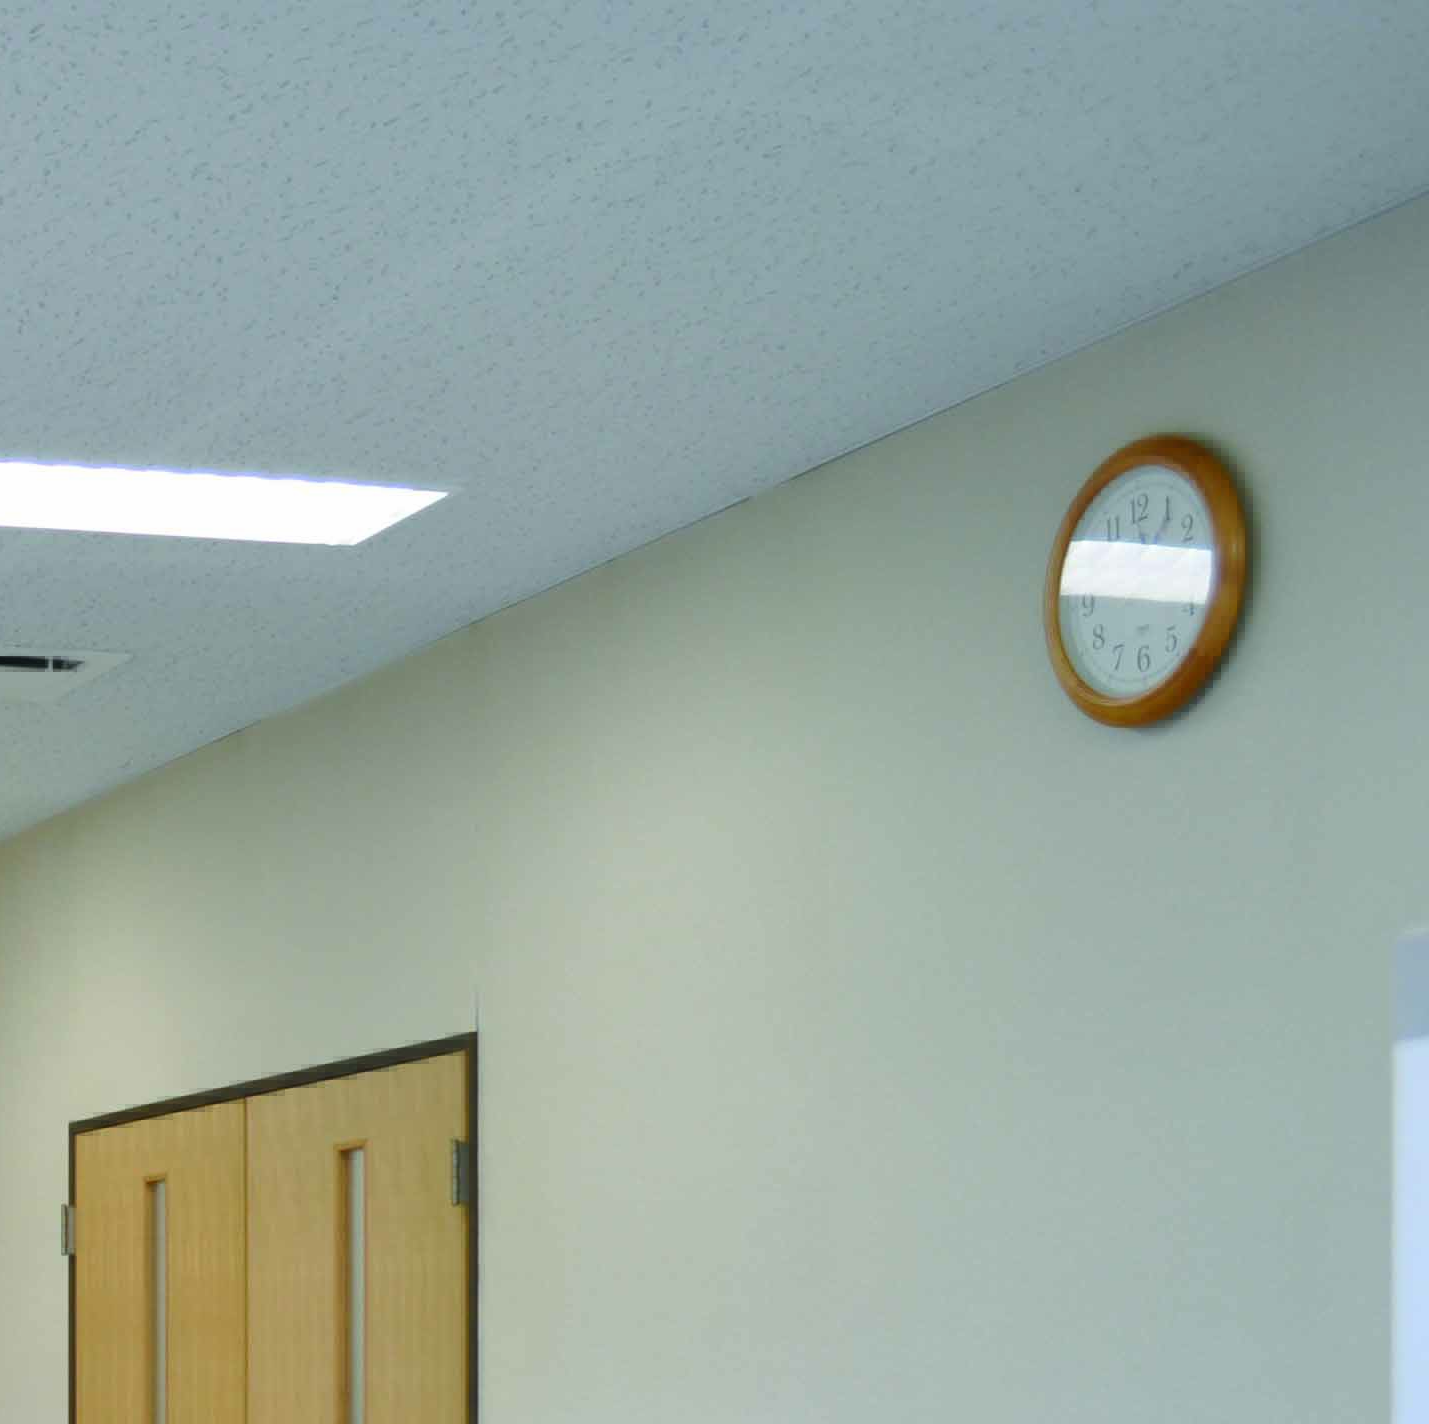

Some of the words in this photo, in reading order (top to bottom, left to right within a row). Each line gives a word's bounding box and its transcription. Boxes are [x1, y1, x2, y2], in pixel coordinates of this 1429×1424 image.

[1130, 493, 1148, 524] 12
[1106, 515, 1120, 541] 11
[1181, 513, 1194, 542] 2
[1081, 593, 1095, 617] 9
[1092, 623, 1105, 651] 8
[1164, 624, 1178, 654] 5
[1112, 643, 1125, 671] 7
[1136, 645, 1151, 673] 6
